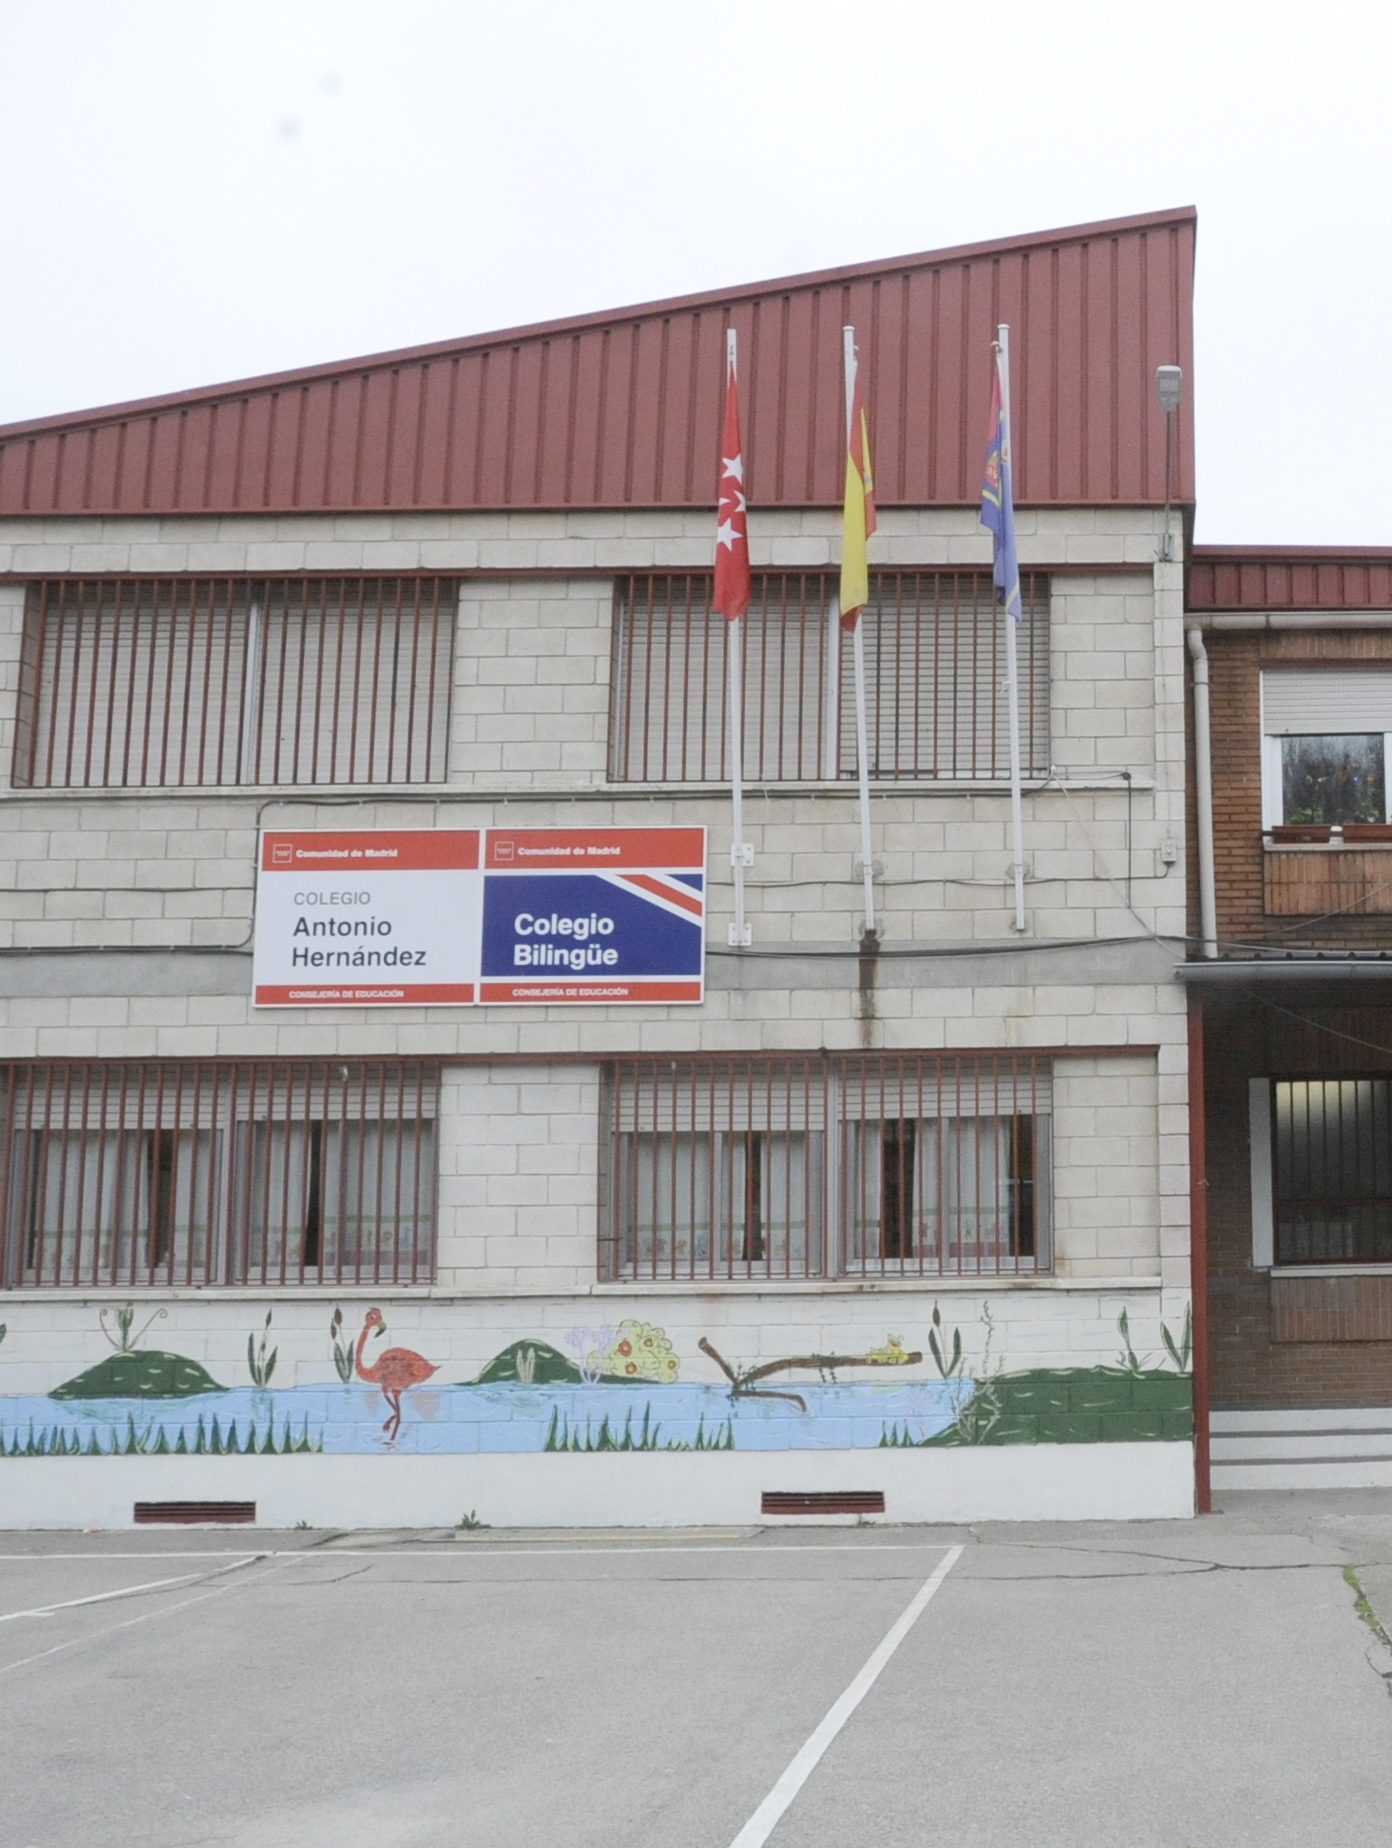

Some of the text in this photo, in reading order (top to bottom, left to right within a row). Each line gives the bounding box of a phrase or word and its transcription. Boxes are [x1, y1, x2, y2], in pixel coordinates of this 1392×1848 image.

[295, 848, 398, 858] Comunidad de Madrid
[517, 846, 621, 856] Comunidad de Madrid
[293, 891, 371, 906] COLEGIO
[293, 916, 392, 937] Antonio
[514, 912, 615, 941] Colegio
[292, 945, 427, 967] Hernández
[513, 943, 619, 971] Bilingüe
[289, 988, 404, 999] CONSEJERÍA DE EDUCACIÓN
[512, 987, 629, 997] CONSEJERÍA DE EDUCACIÓN
